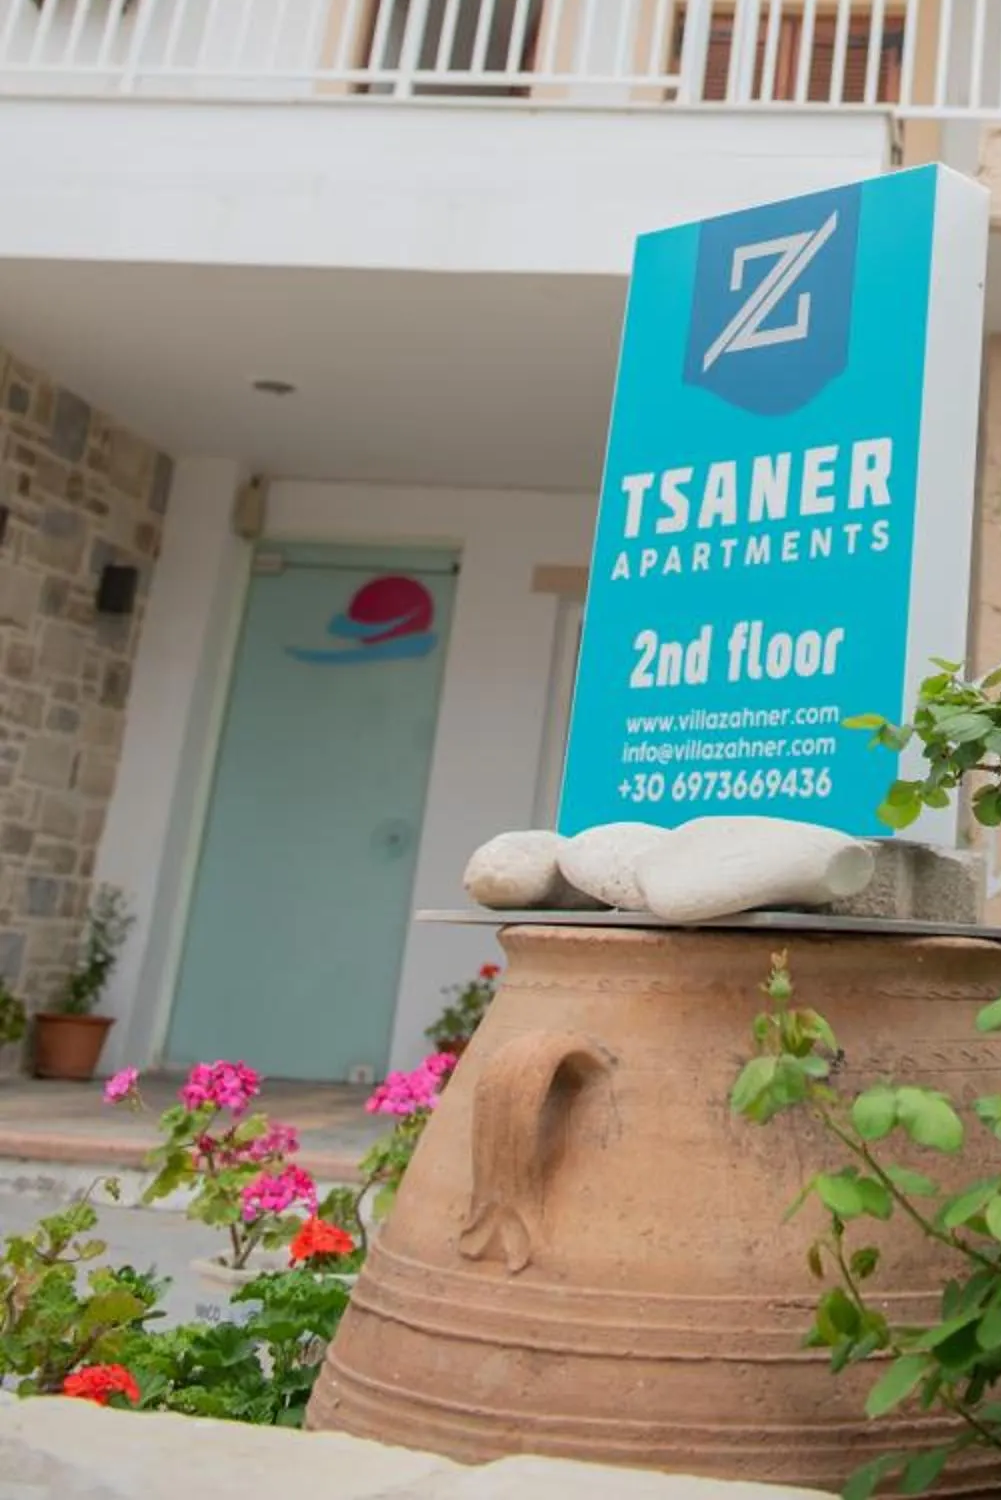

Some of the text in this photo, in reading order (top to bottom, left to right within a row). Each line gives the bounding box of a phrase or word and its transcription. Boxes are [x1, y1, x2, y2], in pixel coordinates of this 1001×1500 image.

[621, 437, 893, 538] TSANER
[611, 519, 890, 580] APARTMENTS
[629, 620, 845, 688] 2nd floor
[626, 705, 839, 733] www.villazahner.com
[622, 737, 836, 764] info@villazahner.com
[618, 767, 832, 802] +30 6973669436
